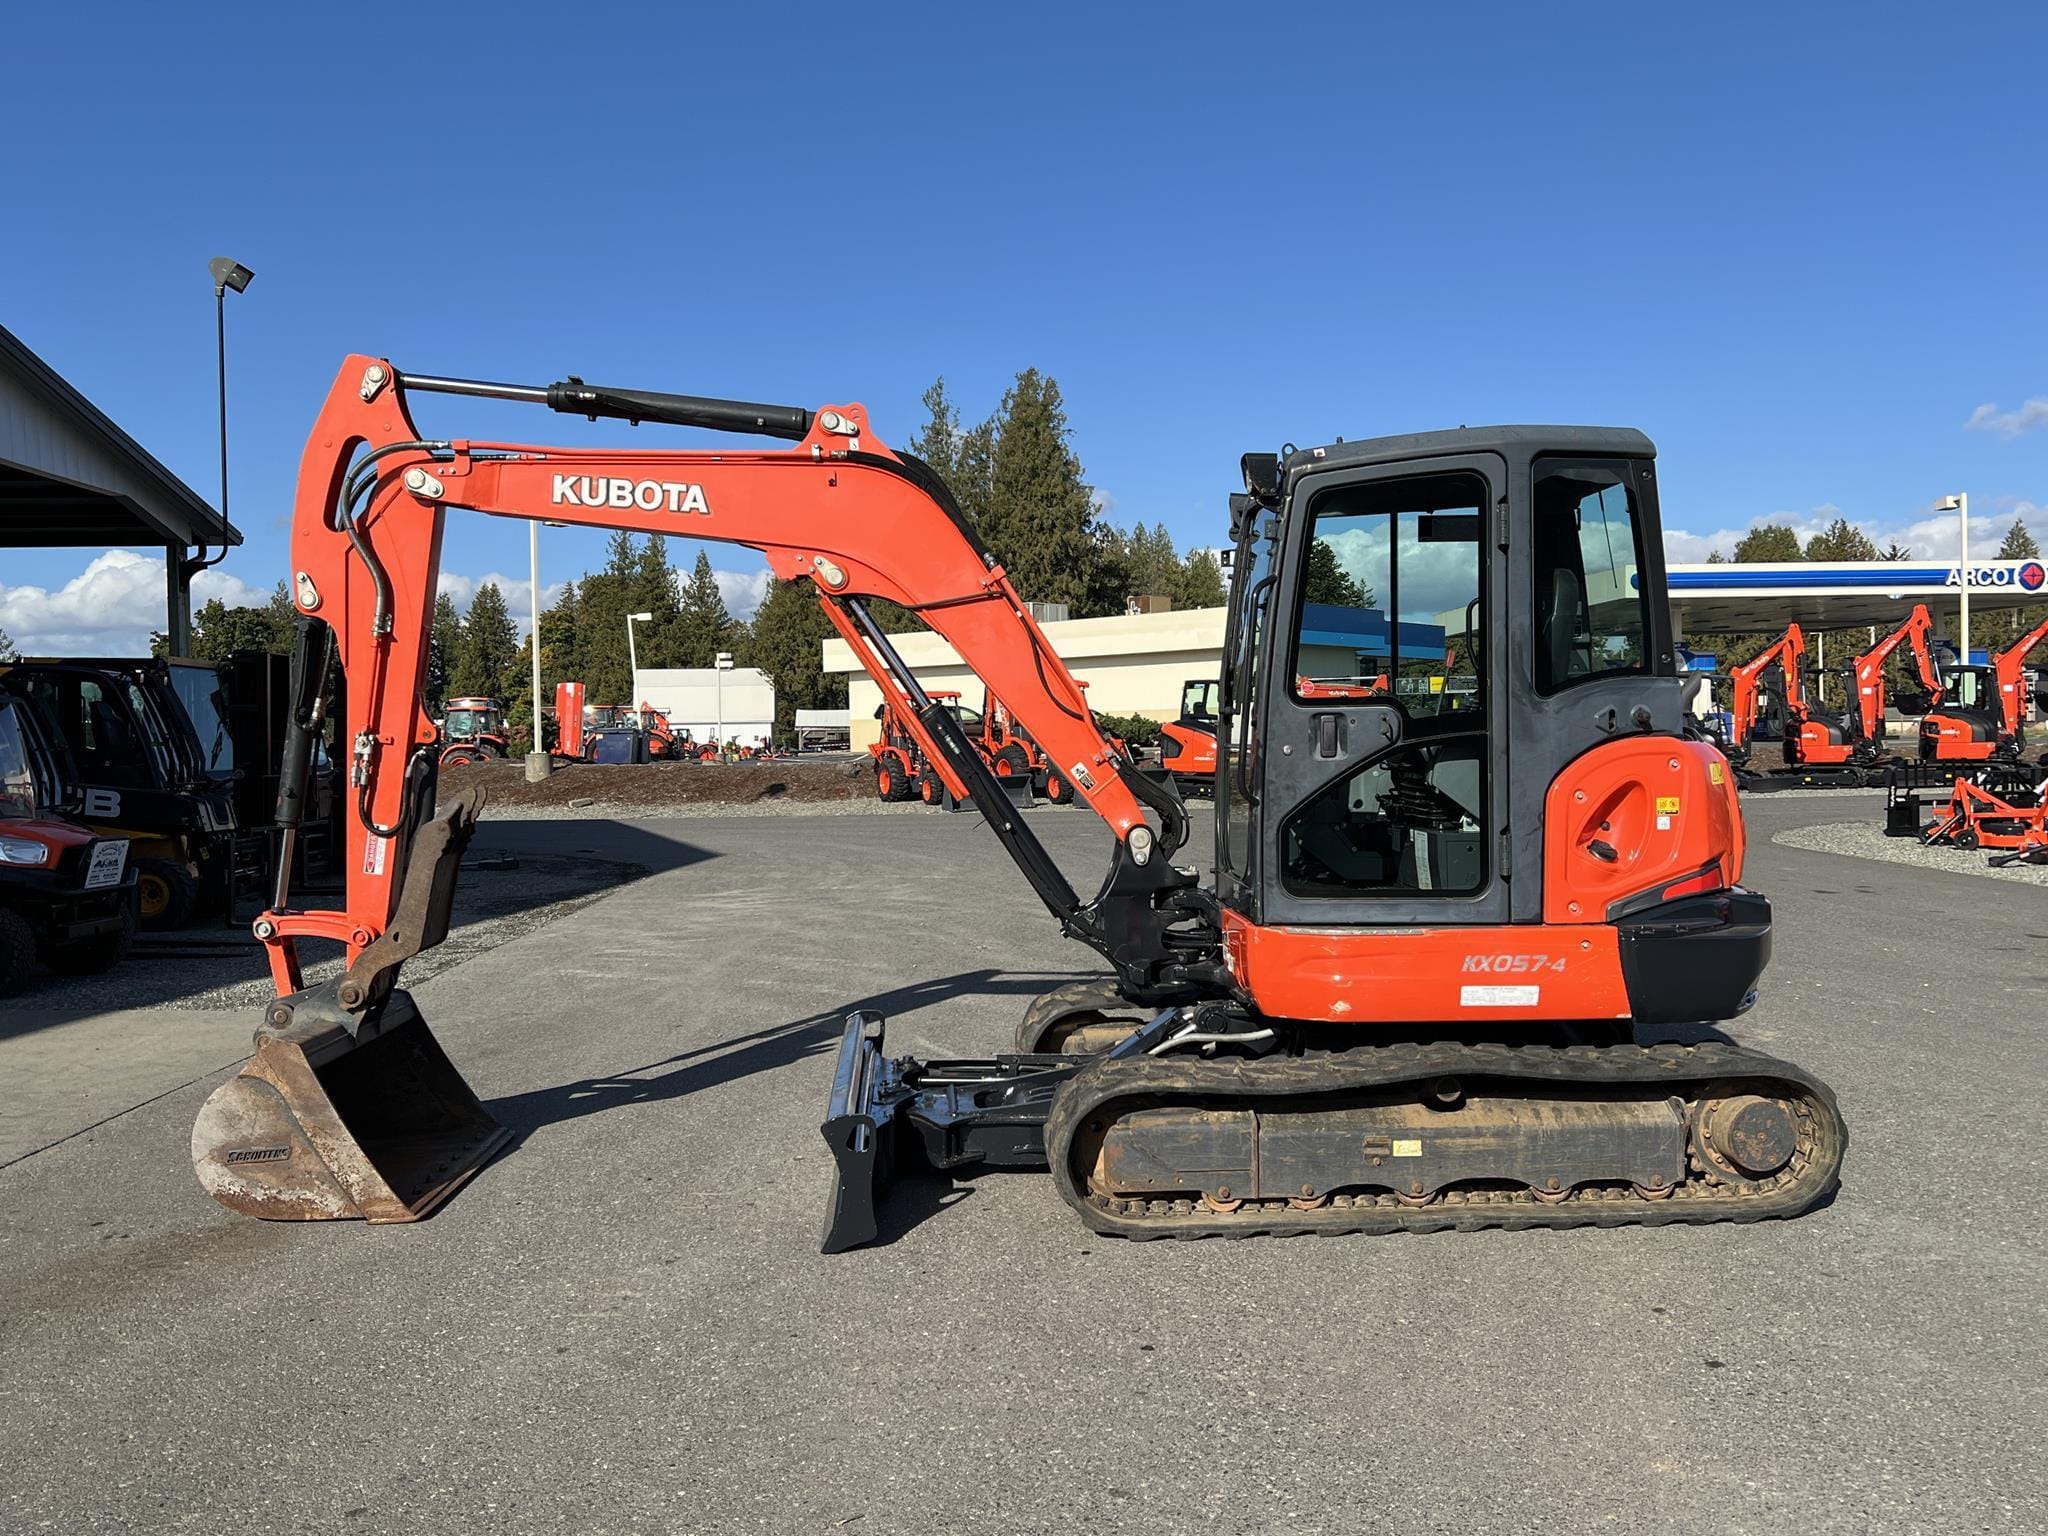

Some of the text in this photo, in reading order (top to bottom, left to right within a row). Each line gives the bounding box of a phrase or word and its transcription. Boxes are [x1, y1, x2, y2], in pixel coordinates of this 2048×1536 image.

[552, 474, 711, 515] KUBOTA
[1945, 568, 2010, 586] ARCO
[1461, 955, 1567, 973] KX057-4
